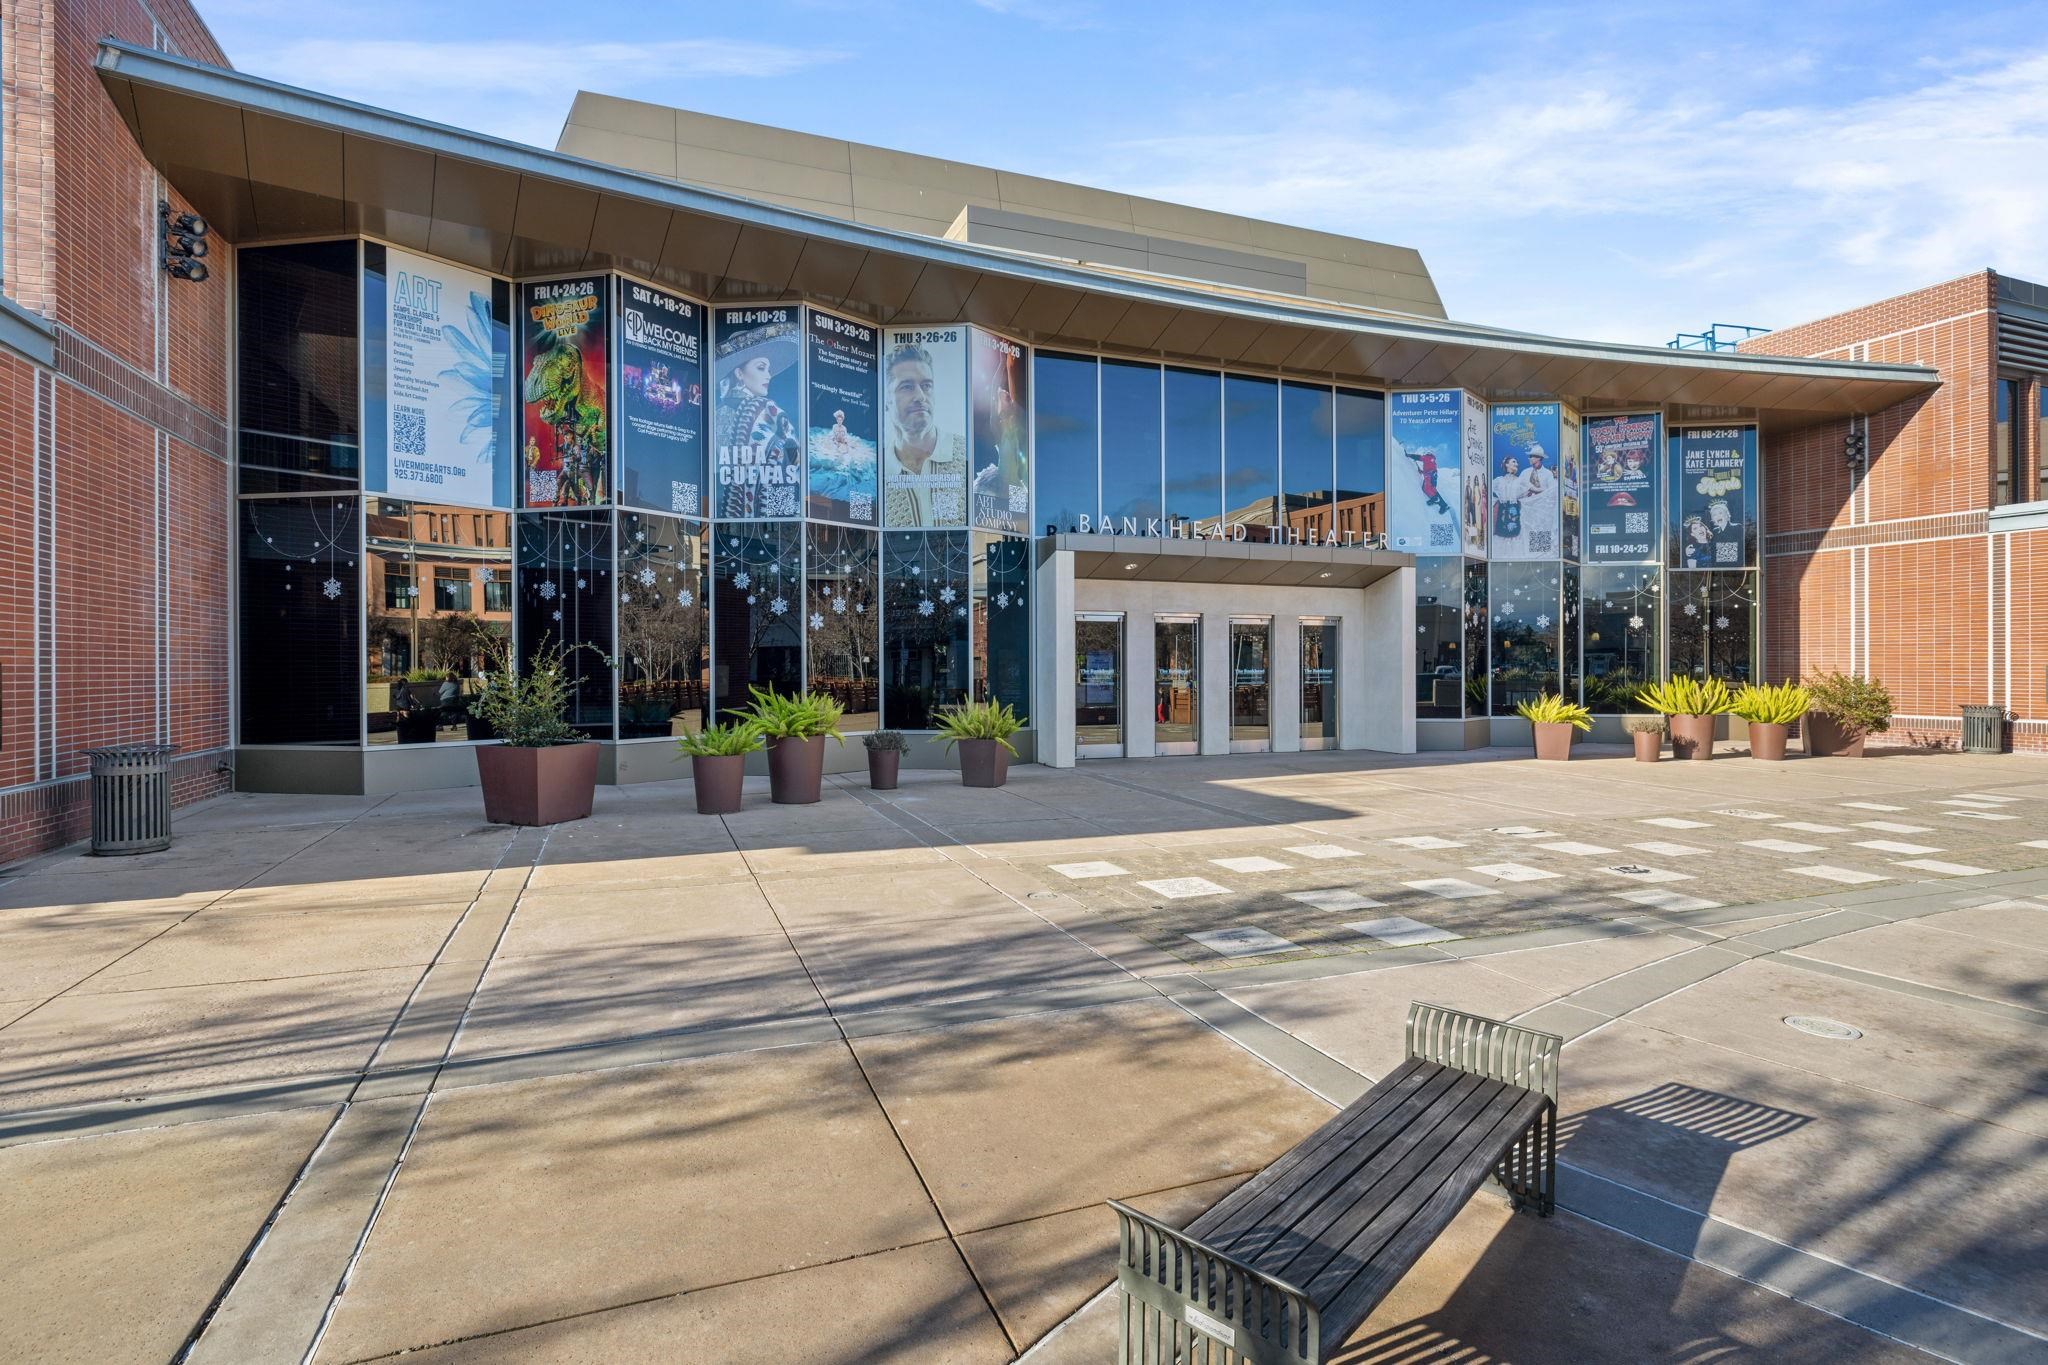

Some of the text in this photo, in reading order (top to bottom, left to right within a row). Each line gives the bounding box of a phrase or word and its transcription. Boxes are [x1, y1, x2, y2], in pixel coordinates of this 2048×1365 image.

[394, 271, 442, 313] ART
[534, 286, 550, 300] FRI
[632, 286, 652, 304] SAT
[530, 295, 598, 320] DINOSAUR
[393, 311, 423, 325] WORKSHOPS
[543, 311, 589, 331] WORLD
[726, 311, 743, 324] FRI
[815, 314, 834, 331] SUN
[404, 320, 415, 330] KIDS
[416, 324, 423, 332] TO
[423, 326, 441, 336] ADULTS
[557, 326, 576, 337] LIVE
[643, 320, 698, 350] WELCOME
[893, 332, 913, 344] THU
[393, 341, 413, 351] Painting
[643, 334, 698, 358] BACK MY FRIENDS
[809, 332, 876, 360] The Other Mozart
[393, 349, 413, 359] Drawing
[817, 347, 828, 356] The
[828, 350, 850, 362] forgotten
[850, 357, 862, 367] story
[393, 357, 415, 366] Ceramics
[817, 355, 868, 374] Mozart's genius sister
[393, 366, 412, 374] Jewelry
[393, 374, 440, 388] Specialty Workshops
[1401, 394, 1419, 404] THU
[393, 404, 425, 416] LEARN MORE
[1423, 408, 1439, 416] Peter
[1496, 407, 1515, 416] MON
[1687, 430, 1700, 439] FRI
[719, 445, 767, 465] AIDA
[1685, 449, 1740, 459] JANE LYNCH &
[1685, 458, 1744, 469] KATE FLANNERY
[394, 468, 443, 484] 925.373.6800
[719, 464, 797, 485] CUEVAS
[976, 494, 996, 508] ABT
[979, 507, 1012, 520] STUDIO
[976, 516, 1018, 531] COMPANY
[1078, 513, 1389, 550] BANKHEAD THEATER
[1595, 545, 1609, 554] FRI
